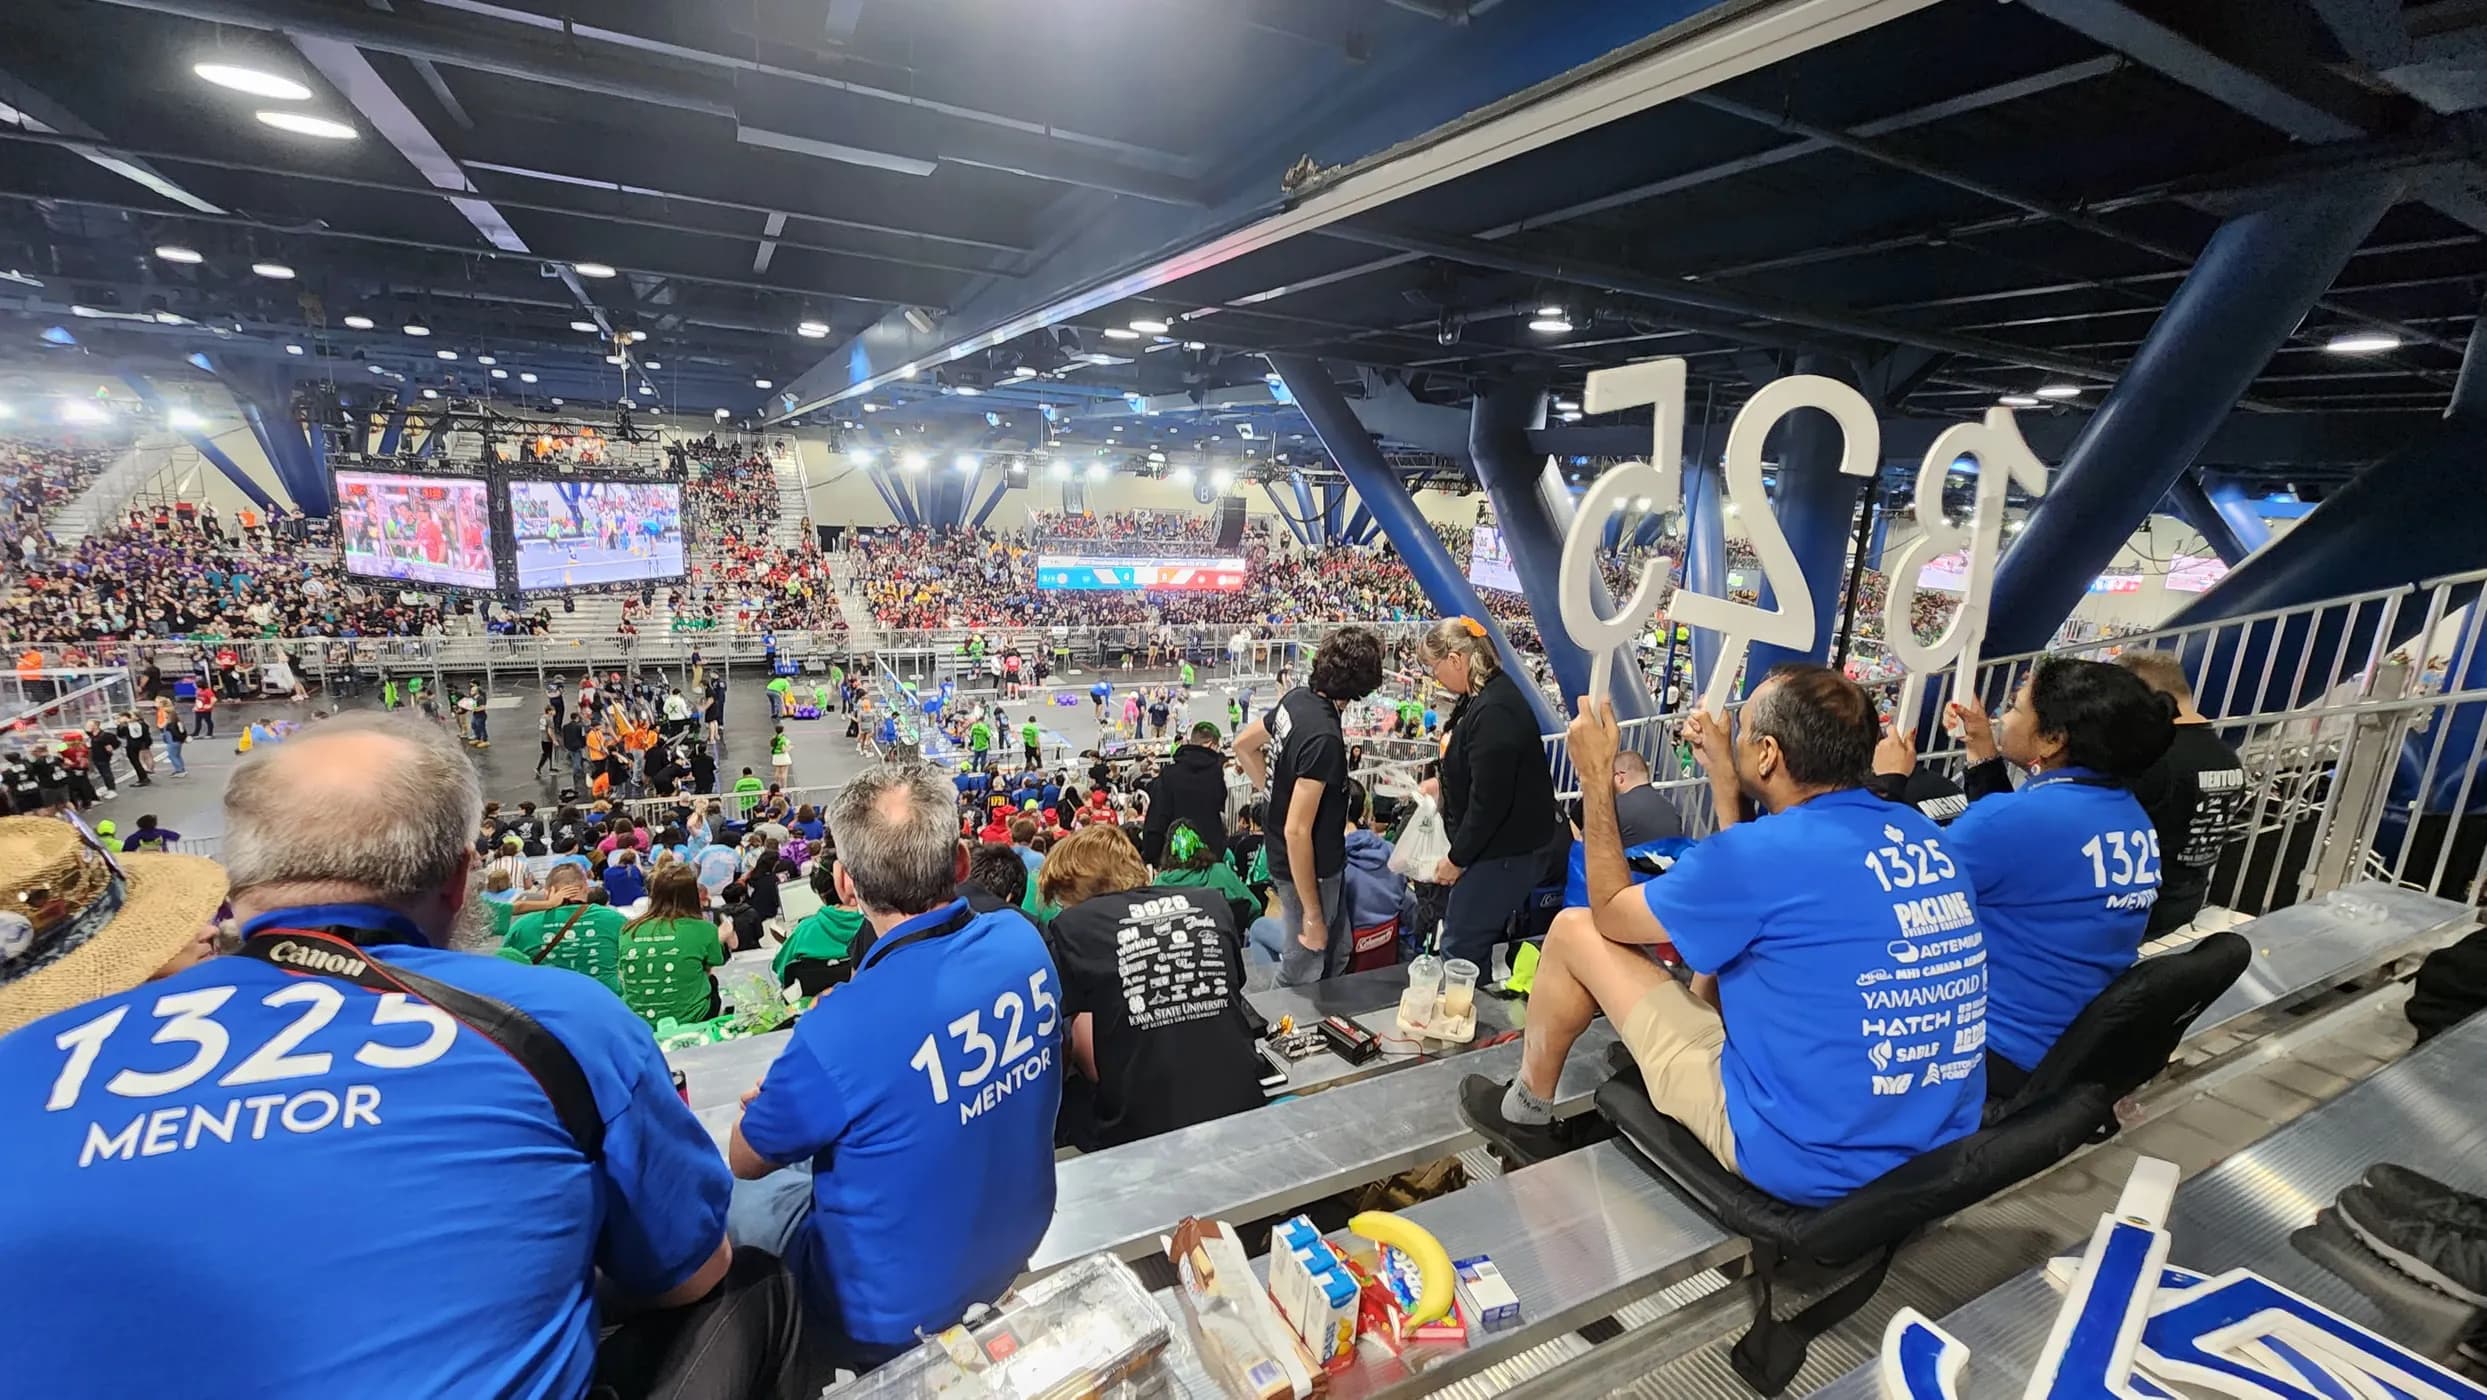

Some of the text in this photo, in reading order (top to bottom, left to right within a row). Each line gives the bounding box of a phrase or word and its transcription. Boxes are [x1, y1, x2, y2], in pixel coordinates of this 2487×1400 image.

[1864, 838, 1956, 892] 1325
[1893, 891, 1970, 929] PACLINE
[268, 939, 368, 978] Canon
[910, 967, 1058, 1106] 1325
[1128, 998, 1230, 1027] IOWA STATE UNIVERSITY
[1862, 1010, 1952, 1037] HATCH
[45, 981, 459, 1112] 1325
[960, 1047, 1054, 1127] MENTOR
[78, 1083, 383, 1168] MENTOR
